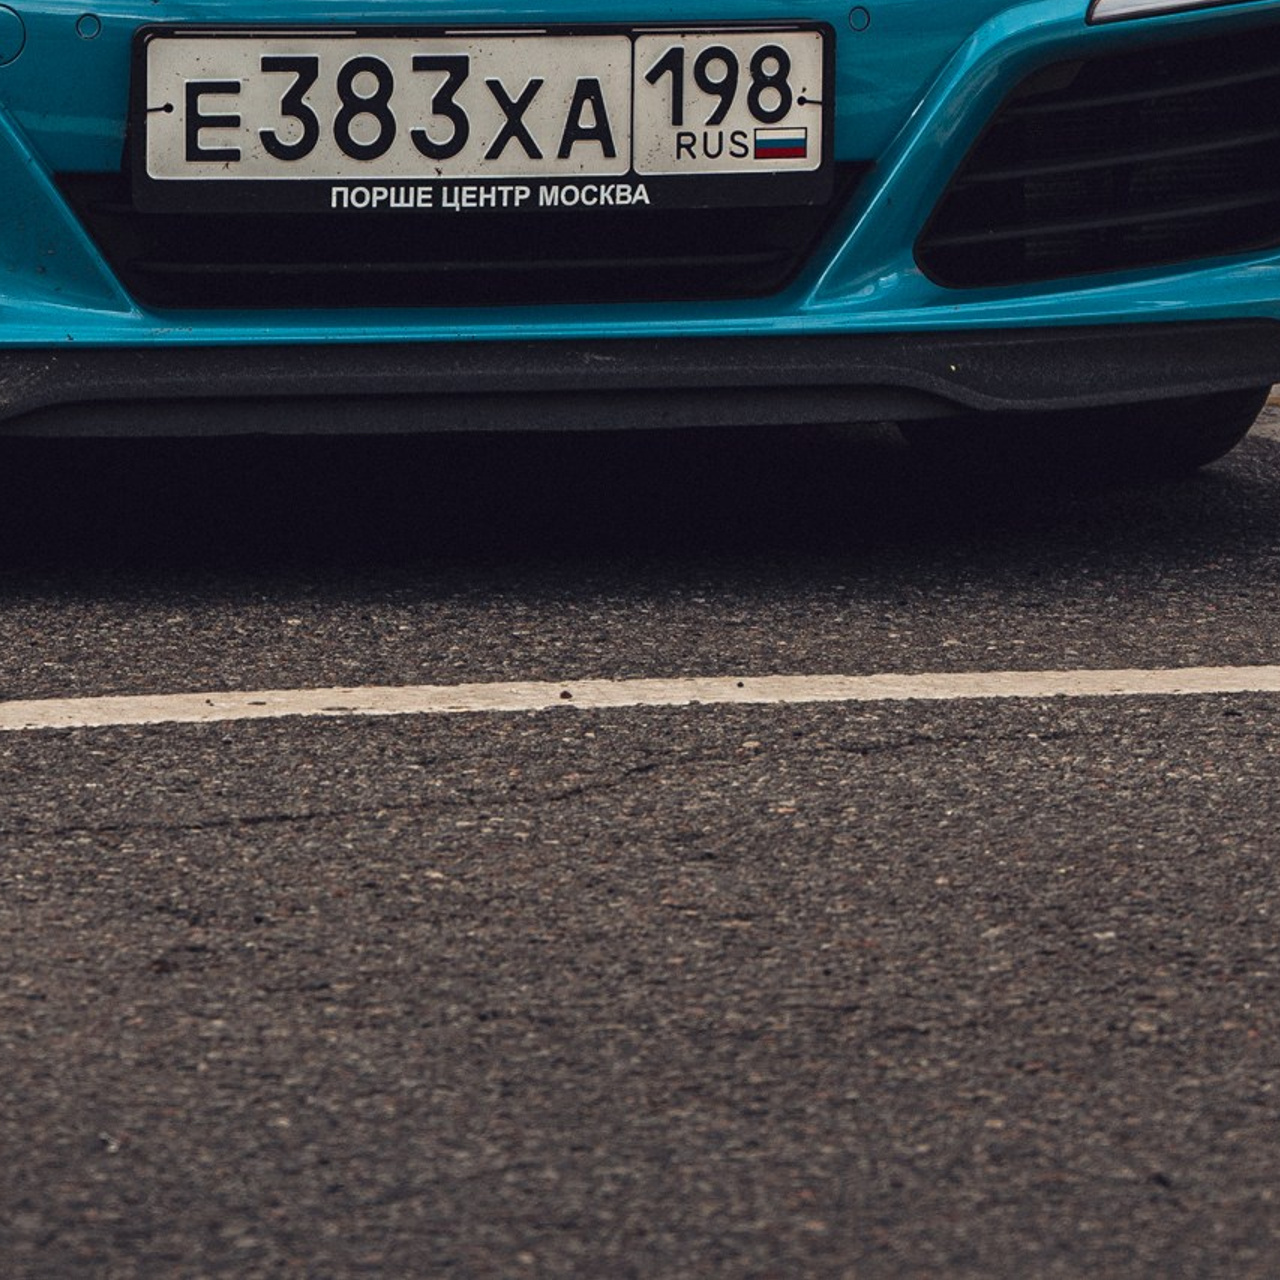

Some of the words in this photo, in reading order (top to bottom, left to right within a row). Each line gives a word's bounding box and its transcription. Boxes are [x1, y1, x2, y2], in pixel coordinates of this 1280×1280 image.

[645, 44, 792, 126] 198
[676, 130, 749, 160] RUS
[331, 186, 433, 208] ПОРШЕ
[442, 185, 531, 211] ЦЕНТР
[539, 184, 650, 206] МОСКВА
